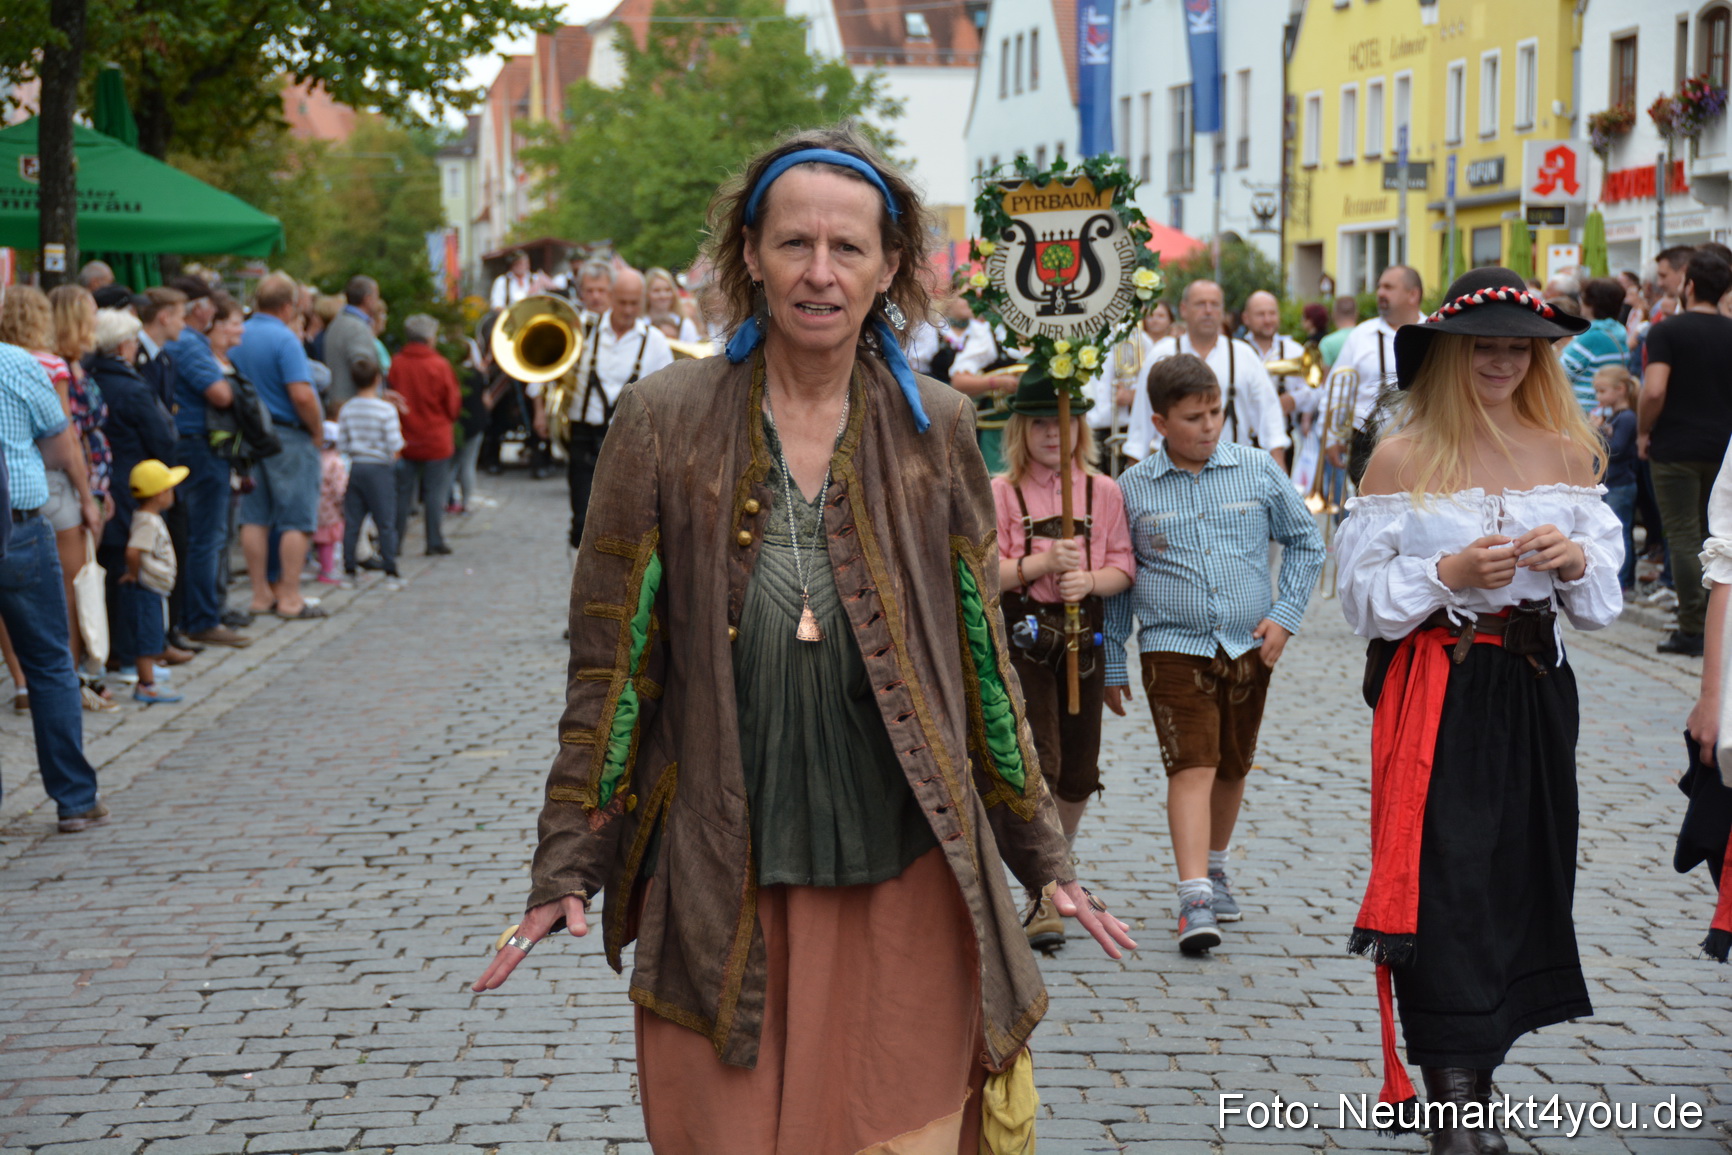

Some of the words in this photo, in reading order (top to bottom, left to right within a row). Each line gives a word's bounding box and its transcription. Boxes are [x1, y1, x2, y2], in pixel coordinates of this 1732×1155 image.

[1348, 38, 1383, 72] HOTEL
[1012, 193, 1102, 212] PYRBAUM
[1037, 322, 1066, 341] DER
[1070, 235, 1137, 339] MARKTGEMEINDE
